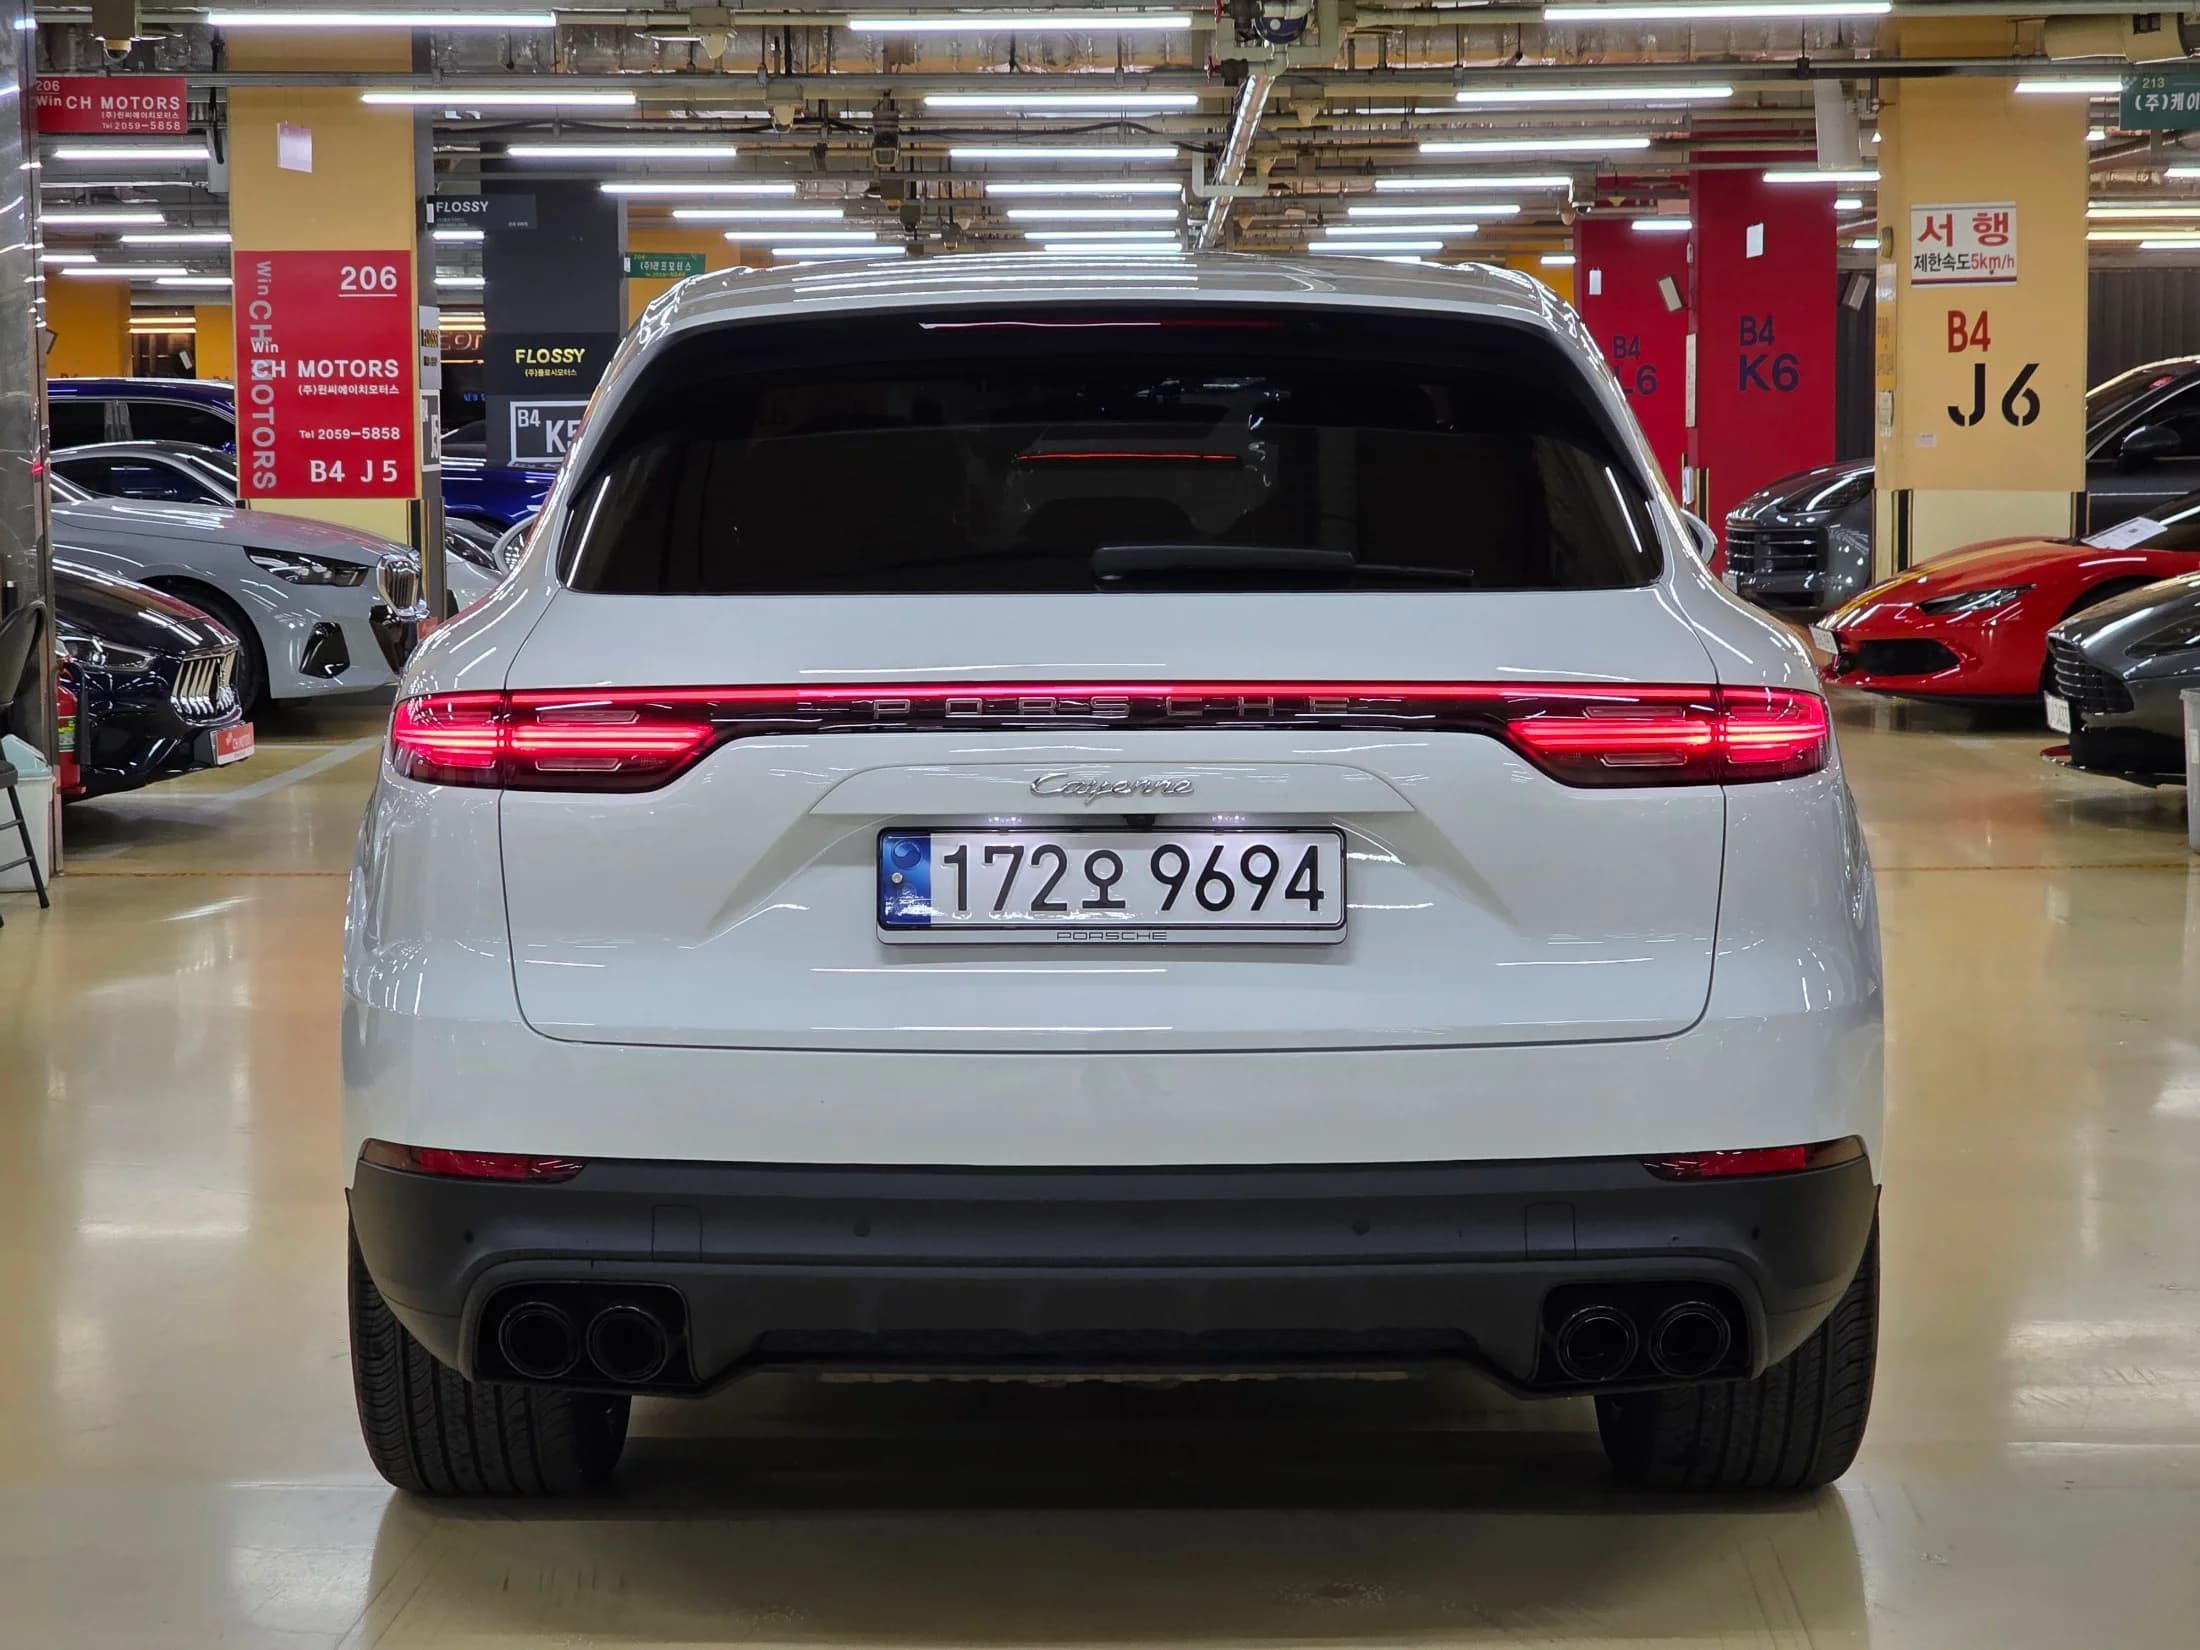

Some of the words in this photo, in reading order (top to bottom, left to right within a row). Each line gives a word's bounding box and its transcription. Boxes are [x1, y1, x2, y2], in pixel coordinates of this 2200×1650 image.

[36, 81, 60, 91] 206
[2142, 77, 2165, 89] 213
[36, 96, 62, 107] Win
[66, 96, 92, 109] CH
[101, 96, 180, 110] MOTORS
[436, 201, 489, 212] FLOSSY
[340, 266, 397, 290] 206
[1739, 315, 1775, 346] B4
[1947, 310, 1991, 353] B4
[251, 338, 279, 353] Win
[1613, 335, 1641, 359] B4
[515, 349, 586, 364] FLOSSY
[252, 360, 286, 378] CH
[298, 359, 399, 378] MOTORS
[1739, 353, 1800, 392] K6
[517, 409, 541, 428] B4
[299, 430, 314, 439] Tel
[318, 427, 400, 440] 2059-5858
[310, 459, 346, 482] B4
[874, 696, 1349, 719] PORSCHE
[1029, 772, 1196, 806] Cayenne
[1150, 844, 1324, 911] 9694
[1056, 930, 1168, 941] PORSCHE
